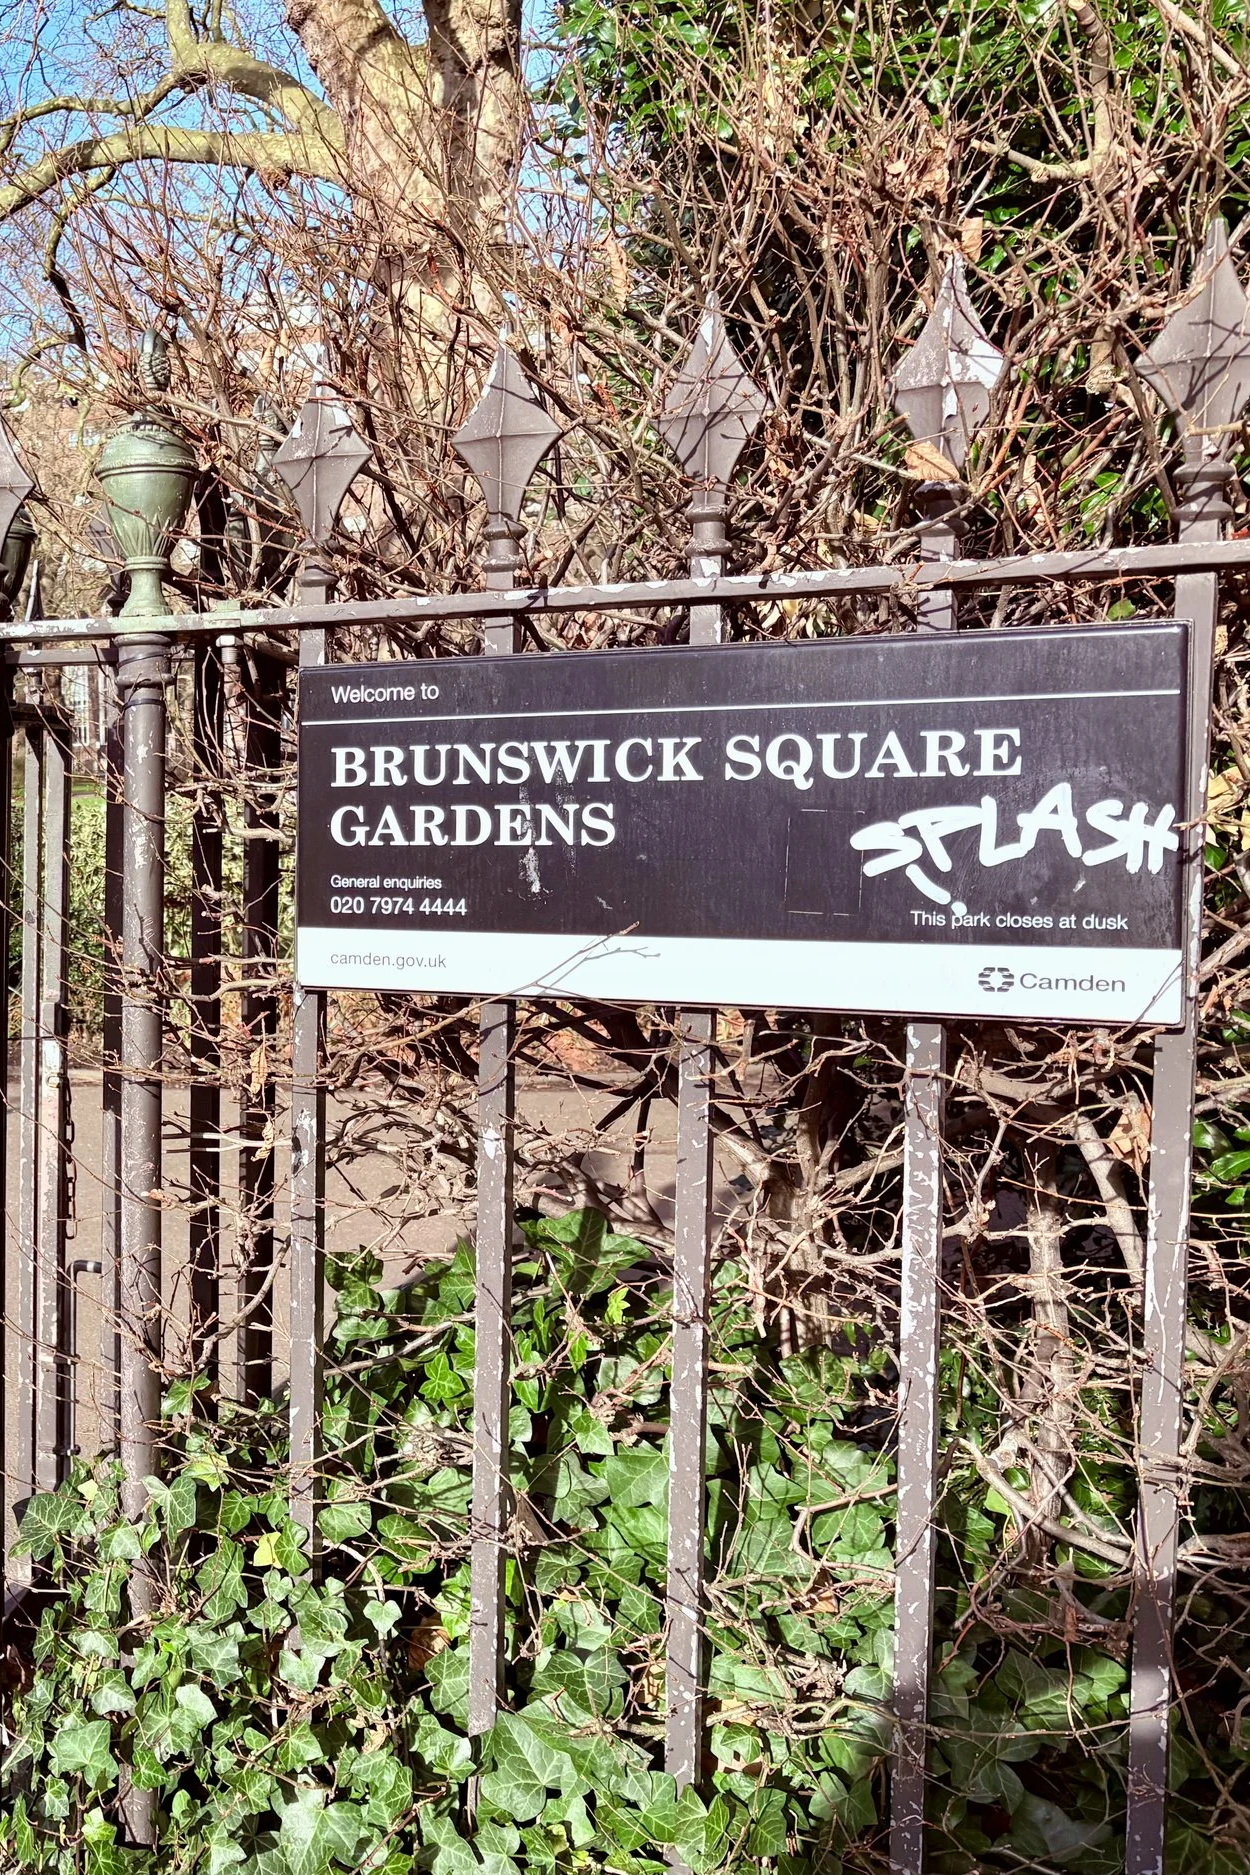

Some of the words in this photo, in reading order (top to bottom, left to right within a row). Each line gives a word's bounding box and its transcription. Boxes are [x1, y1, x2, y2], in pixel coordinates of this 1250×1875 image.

[330, 684, 415, 703] Welcome
[421, 682, 439, 699] to
[330, 736, 703, 788] BRUNSWICK
[724, 728, 1023, 790] SQUARE
[330, 802, 616, 847] GARDENS
[850, 782, 1180, 885] SPLASH
[330, 874, 380, 889] General
[383, 874, 443, 891] enquiries
[330, 896, 365, 914] 020
[369, 896, 415, 915] 7974
[418, 897, 468, 916] 4444
[909, 910, 946, 927] This
[952, 910, 991, 930] park
[996, 911, 1054, 929] closes
[1059, 913, 1077, 929] at
[1082, 913, 1129, 930] dusk
[330, 952, 447, 970] camden.gov.uk
[1019, 972, 1126, 992] Camden
